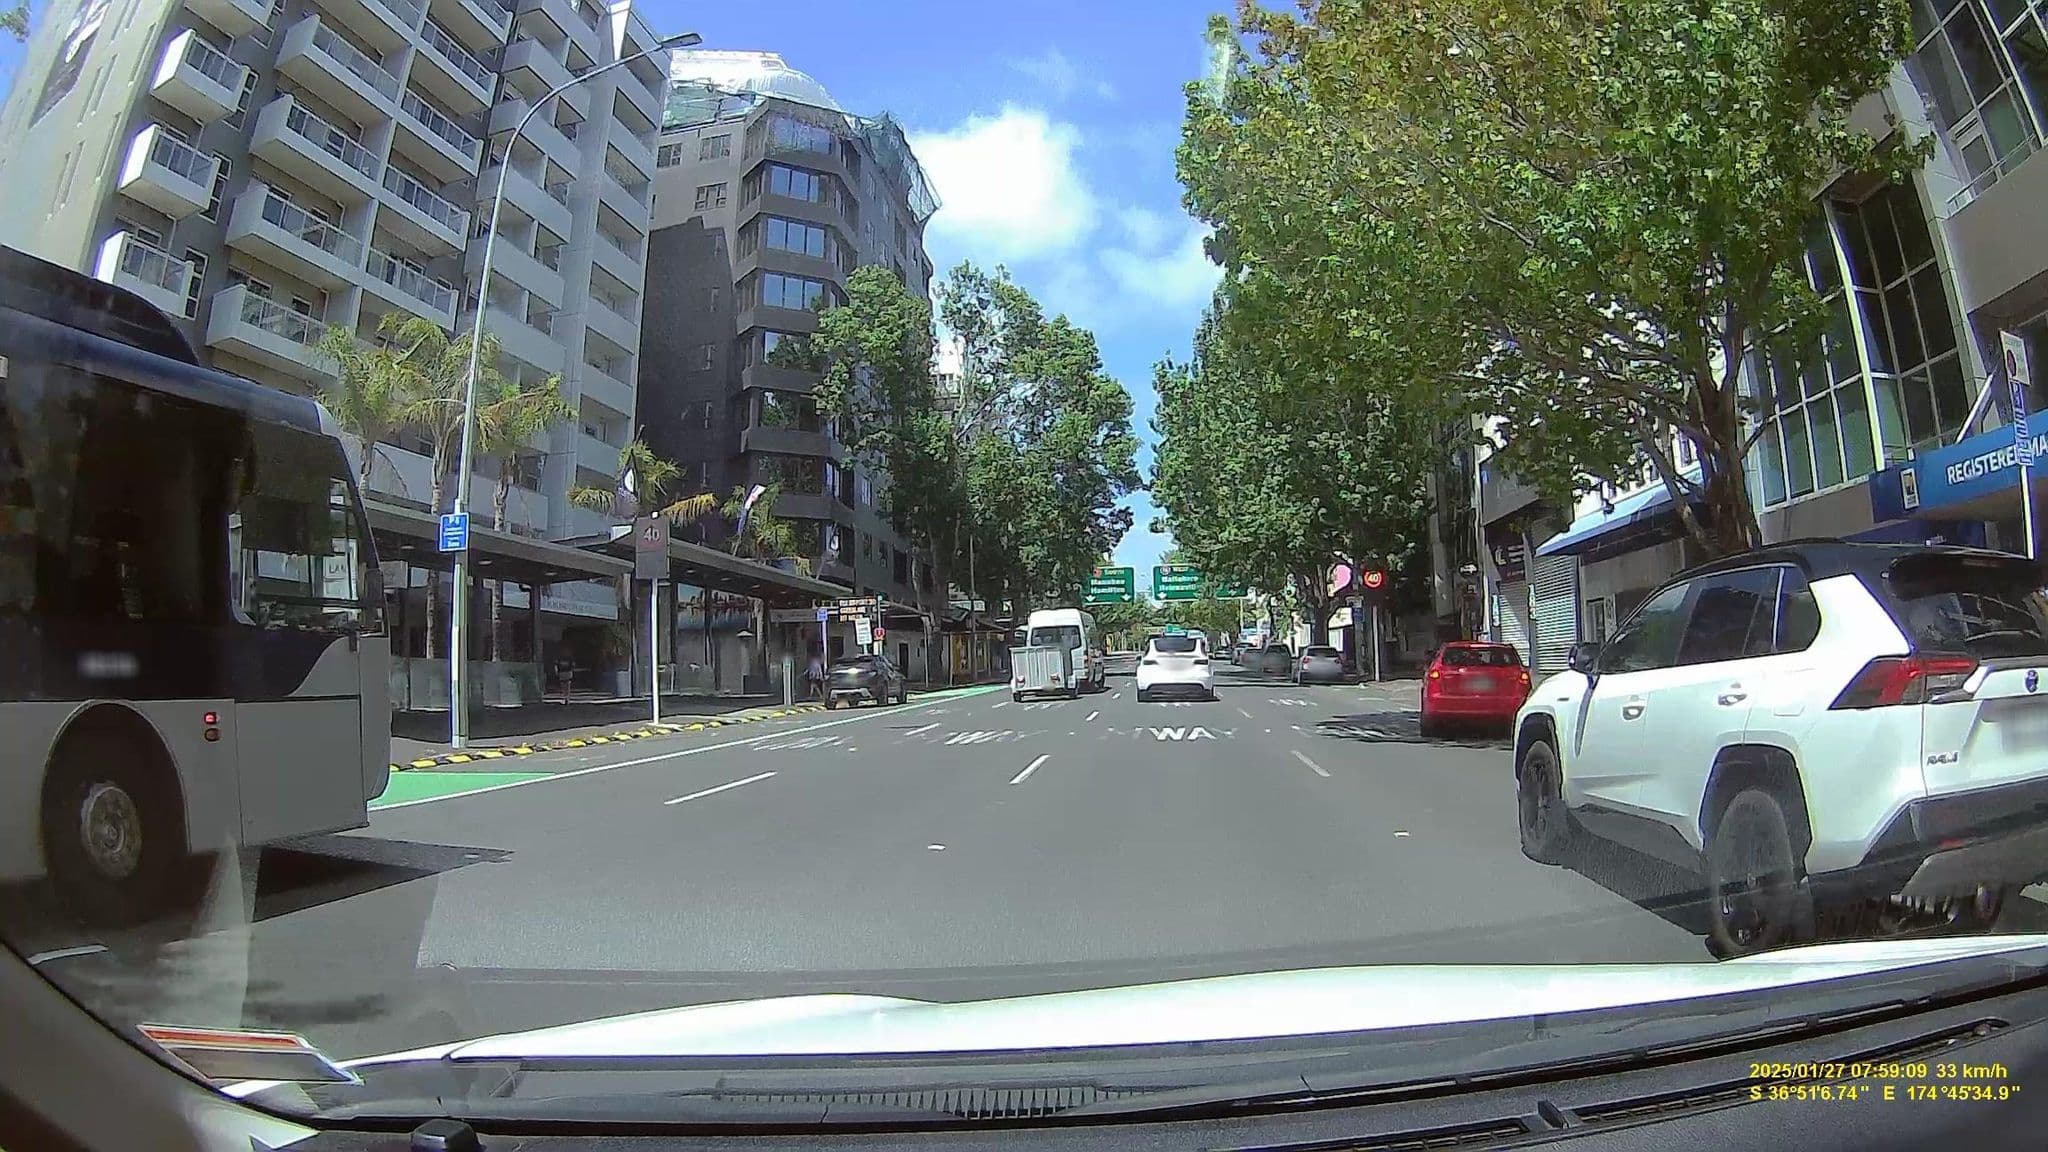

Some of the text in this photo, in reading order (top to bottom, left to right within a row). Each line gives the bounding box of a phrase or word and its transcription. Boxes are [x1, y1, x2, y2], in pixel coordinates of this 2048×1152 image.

[1946, 444, 2019, 485] REGISTERE
[643, 527, 660, 542] 40
[1367, 573, 1379, 583] 40
